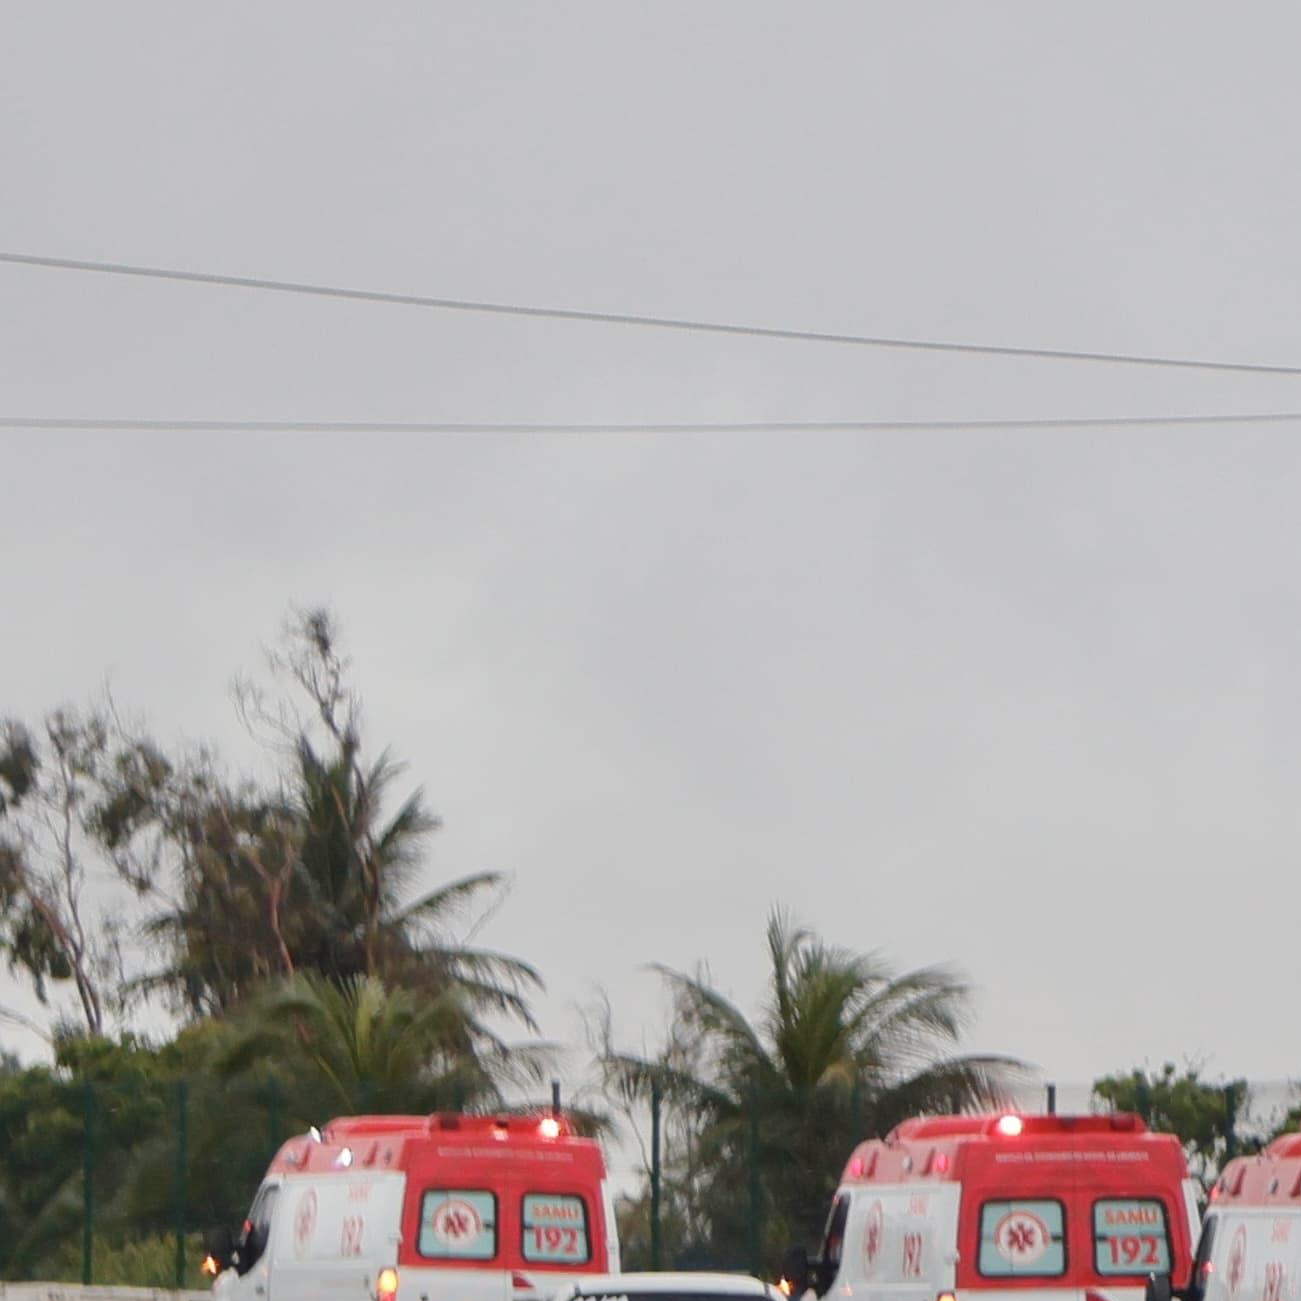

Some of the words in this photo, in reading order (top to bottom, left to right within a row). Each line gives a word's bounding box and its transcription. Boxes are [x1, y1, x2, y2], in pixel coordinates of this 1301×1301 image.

[532, 1203, 580, 1220] SAMU
[1105, 1207, 1158, 1225] SAMU
[532, 1226, 579, 1254] 192
[1107, 1234, 1160, 1266] 192
